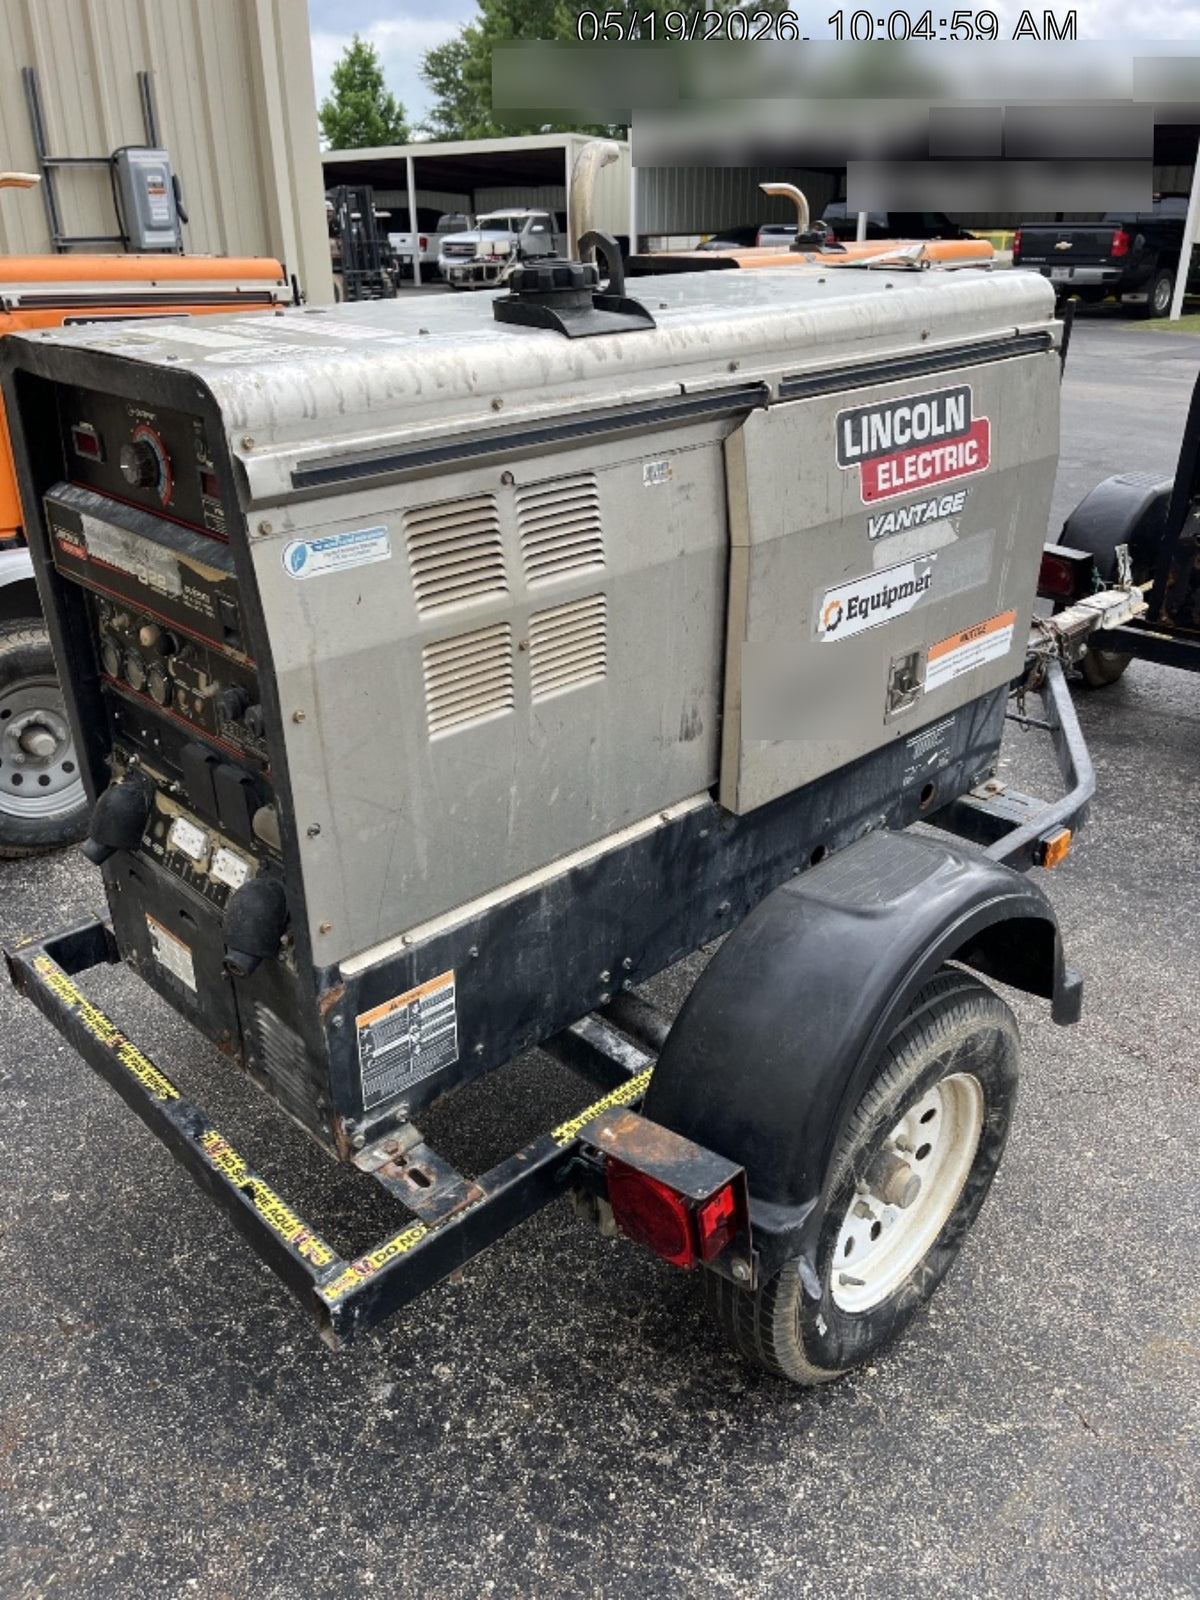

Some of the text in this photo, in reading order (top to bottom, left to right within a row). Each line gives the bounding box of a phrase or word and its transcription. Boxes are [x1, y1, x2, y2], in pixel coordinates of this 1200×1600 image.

[844, 394, 965, 458] LINCOLN
[877, 439, 978, 492] ELECTRIC
[867, 489, 968, 540] VANTAGE
[373, 1244, 399, 1263] DO
